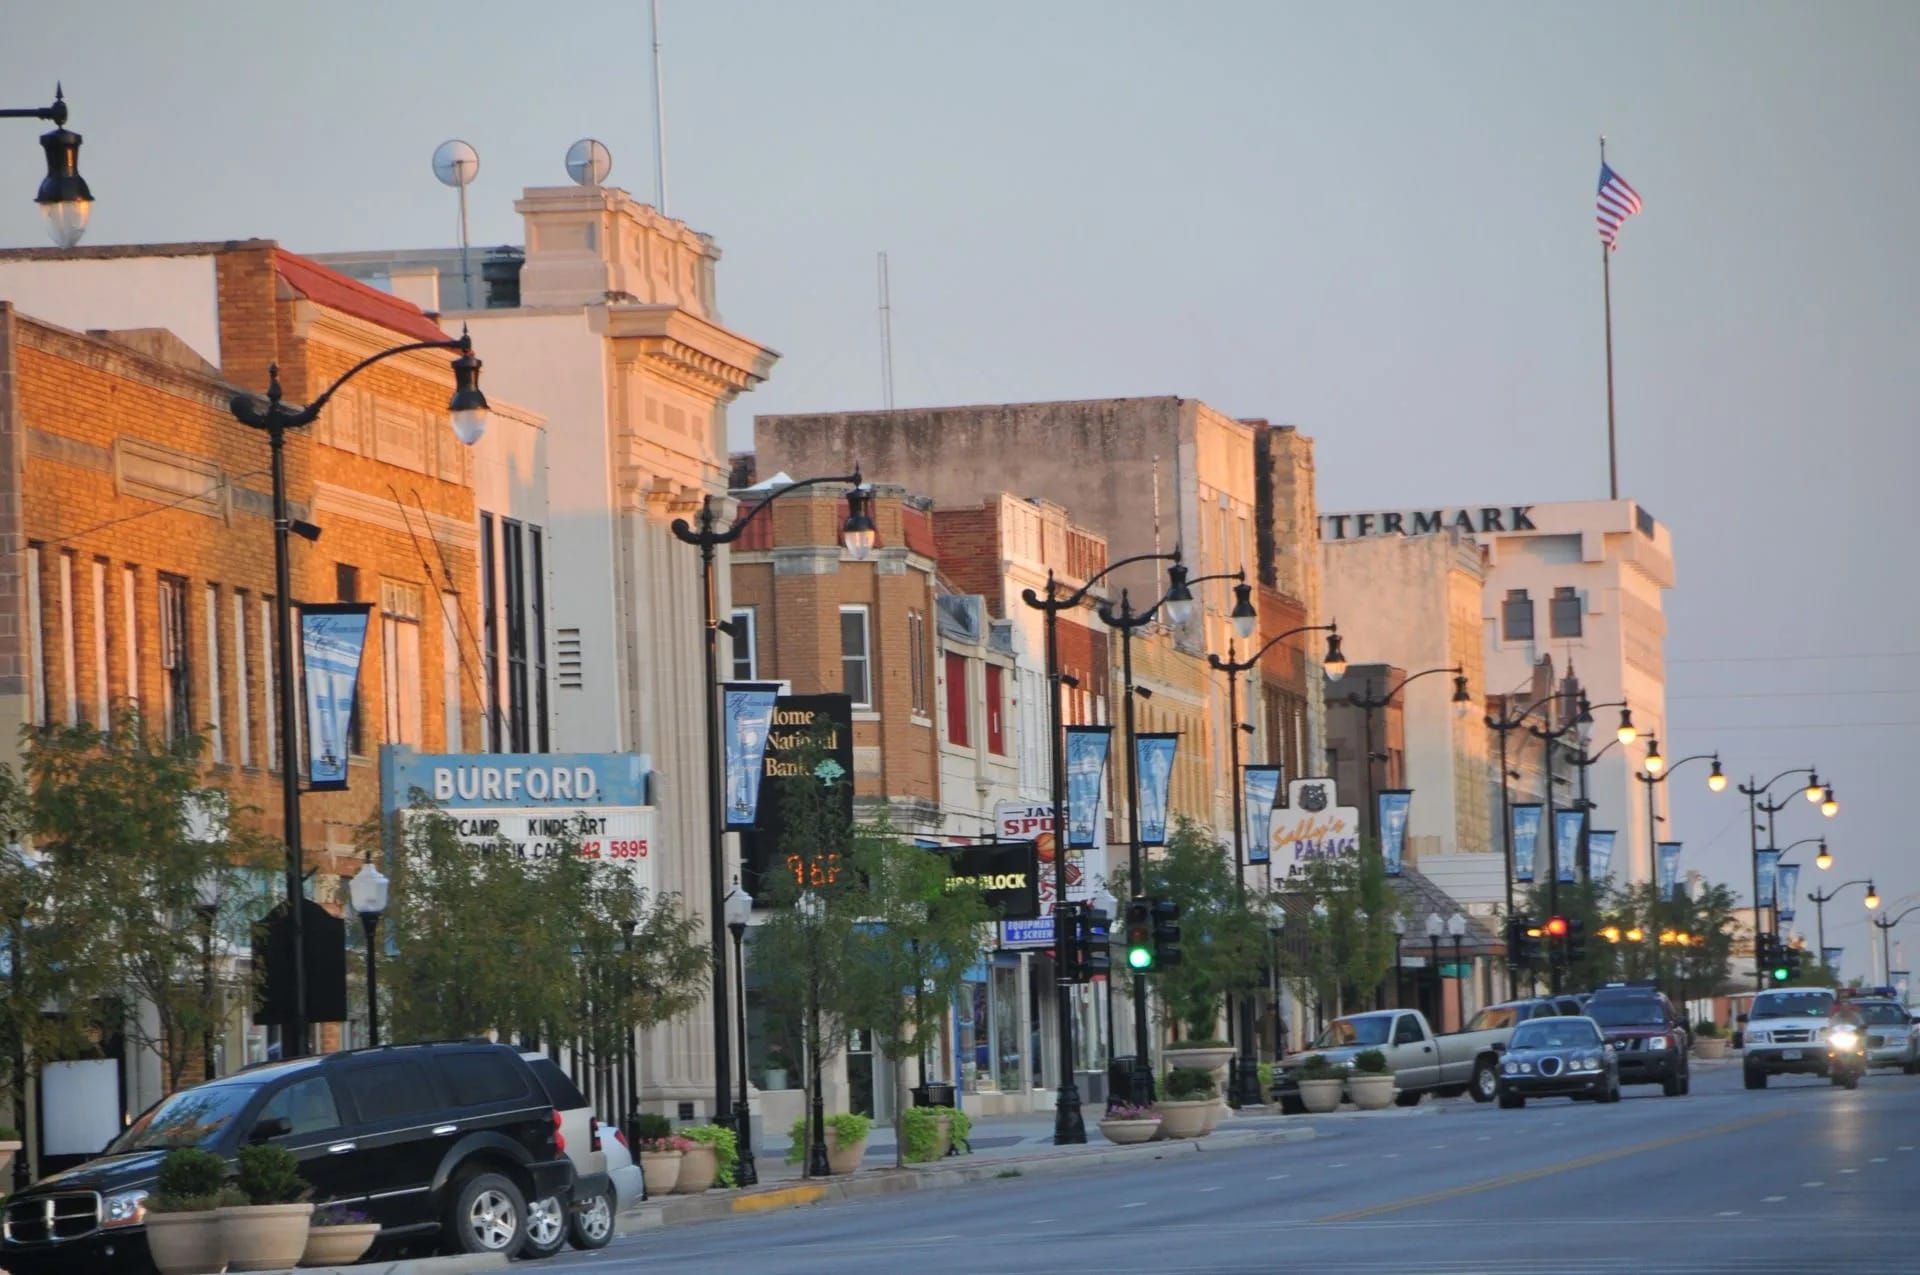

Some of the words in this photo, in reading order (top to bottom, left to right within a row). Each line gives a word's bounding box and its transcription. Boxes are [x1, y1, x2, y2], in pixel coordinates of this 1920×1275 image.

[765, 729, 839, 750] Natioal
[434, 766, 596, 802] BURFORD
[610, 840, 648, 859] 5895
